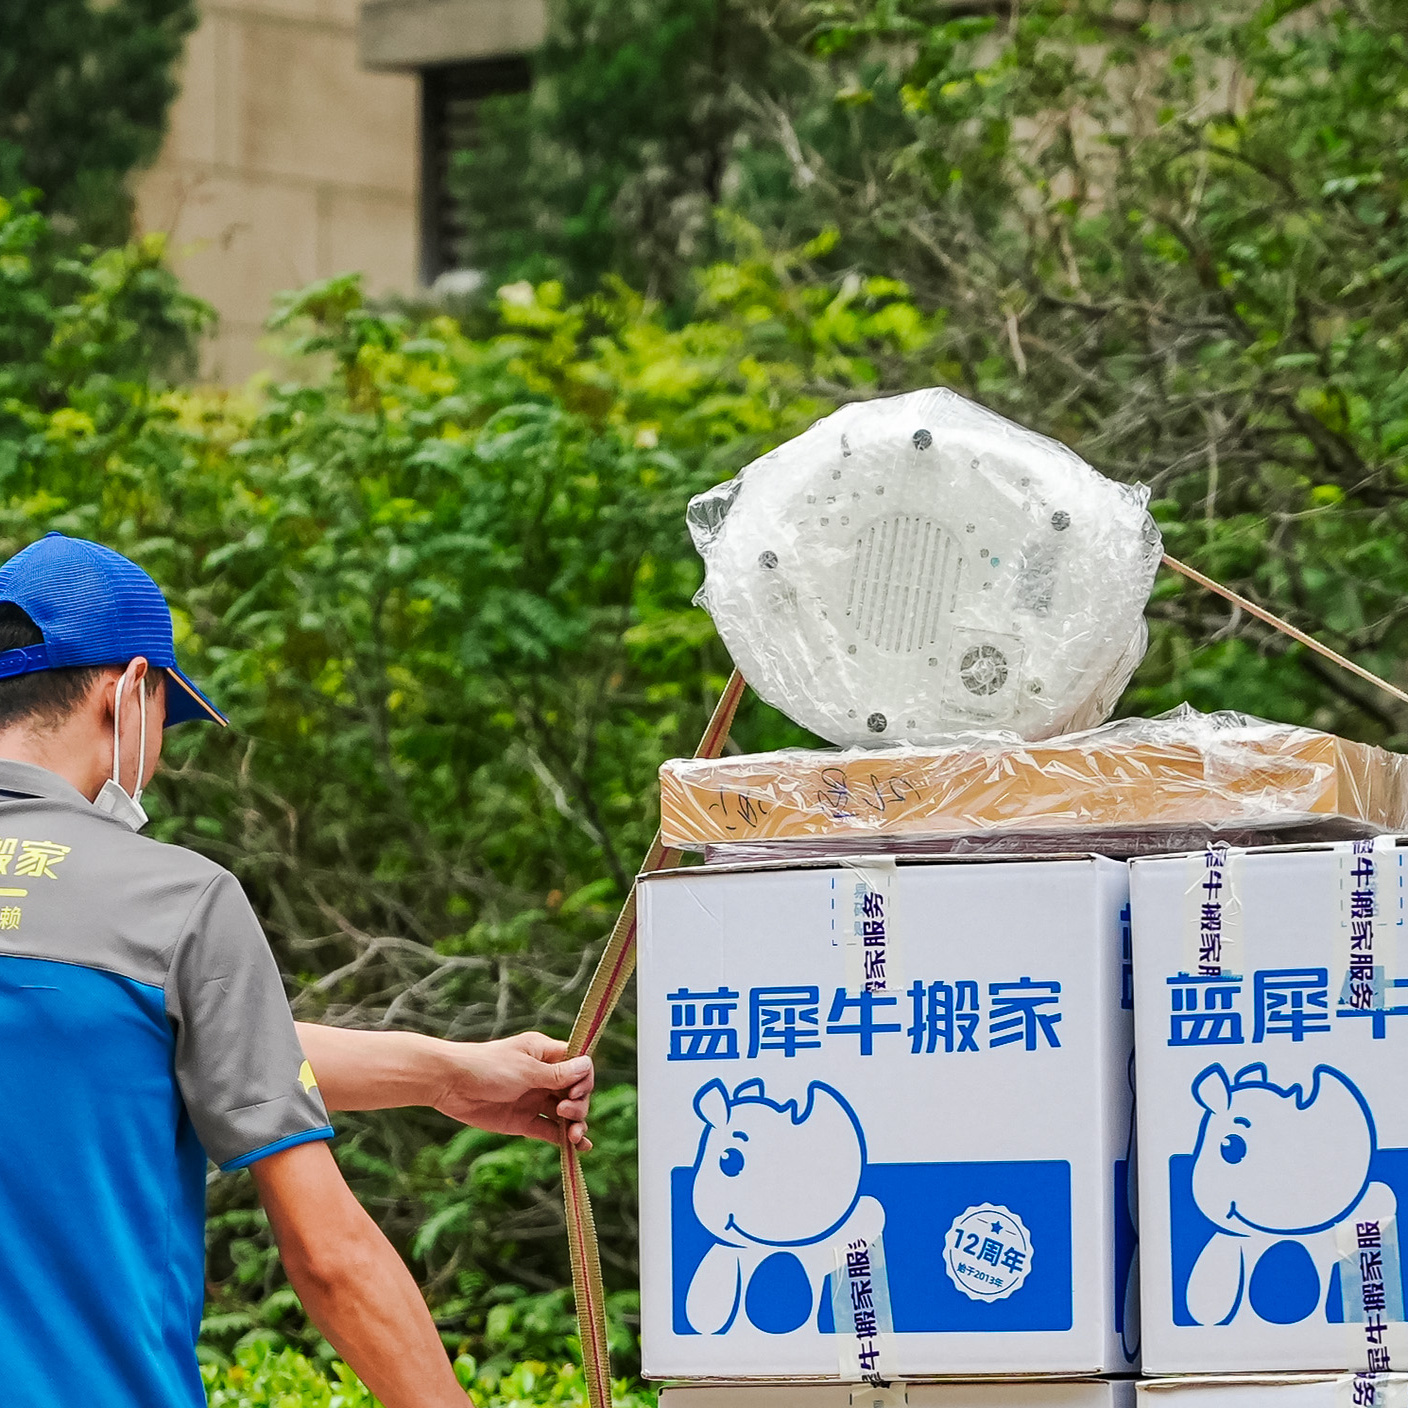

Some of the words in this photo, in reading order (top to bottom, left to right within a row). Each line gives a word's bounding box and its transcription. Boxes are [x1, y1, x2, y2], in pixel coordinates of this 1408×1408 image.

[667, 977, 1062, 1062] 蓝犀牛搬家
[953, 1228, 1026, 1274] 12周年
[956, 1262, 1004, 1288] 始于2013年
